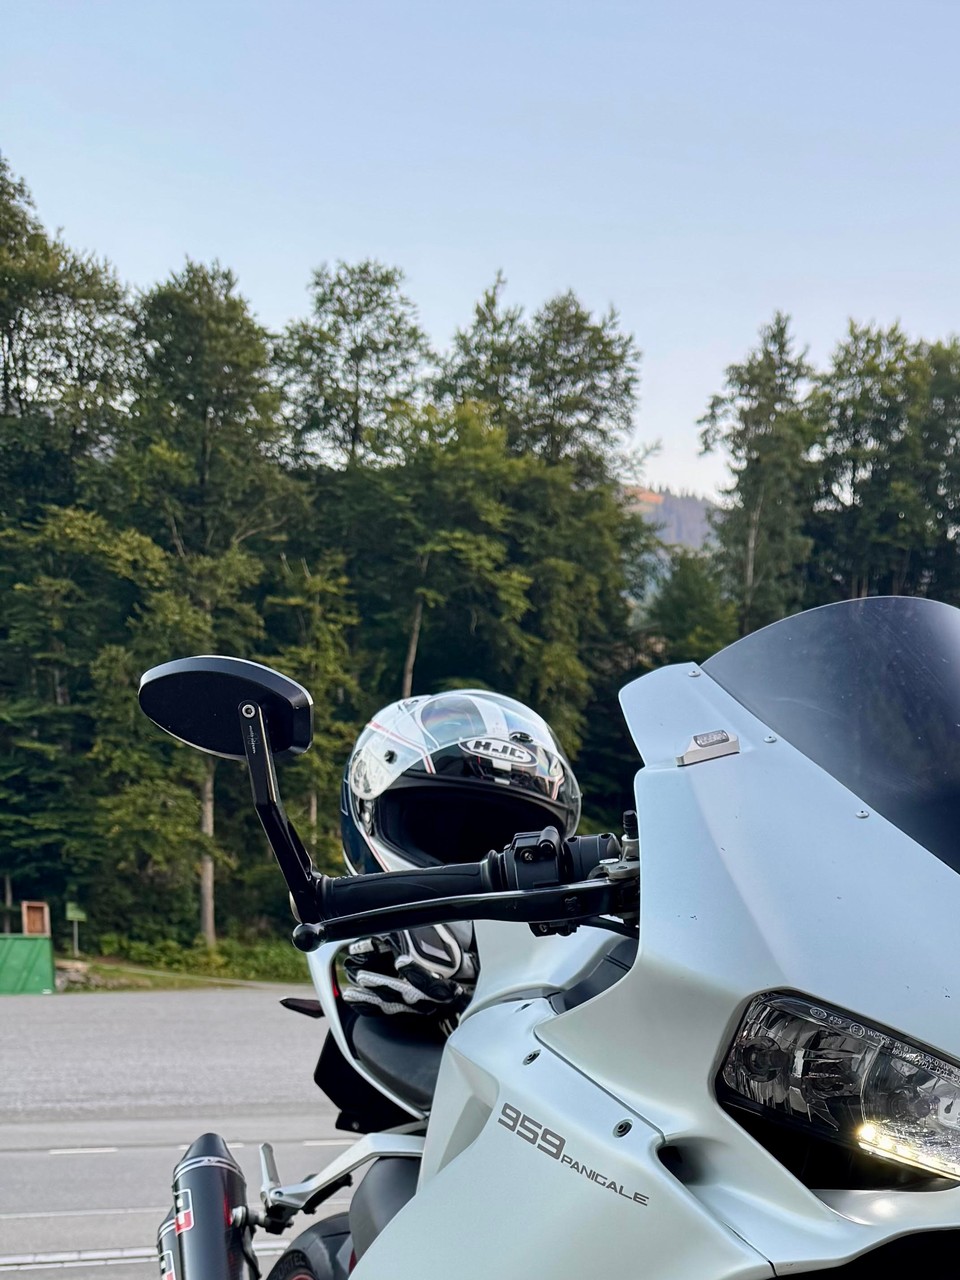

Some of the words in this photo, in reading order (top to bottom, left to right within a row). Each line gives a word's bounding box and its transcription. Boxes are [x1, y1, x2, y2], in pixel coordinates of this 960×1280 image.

[473, 740, 525, 759] HJC
[498, 1102, 566, 1160] 959
[560, 1153, 650, 1206] PANIGALE
